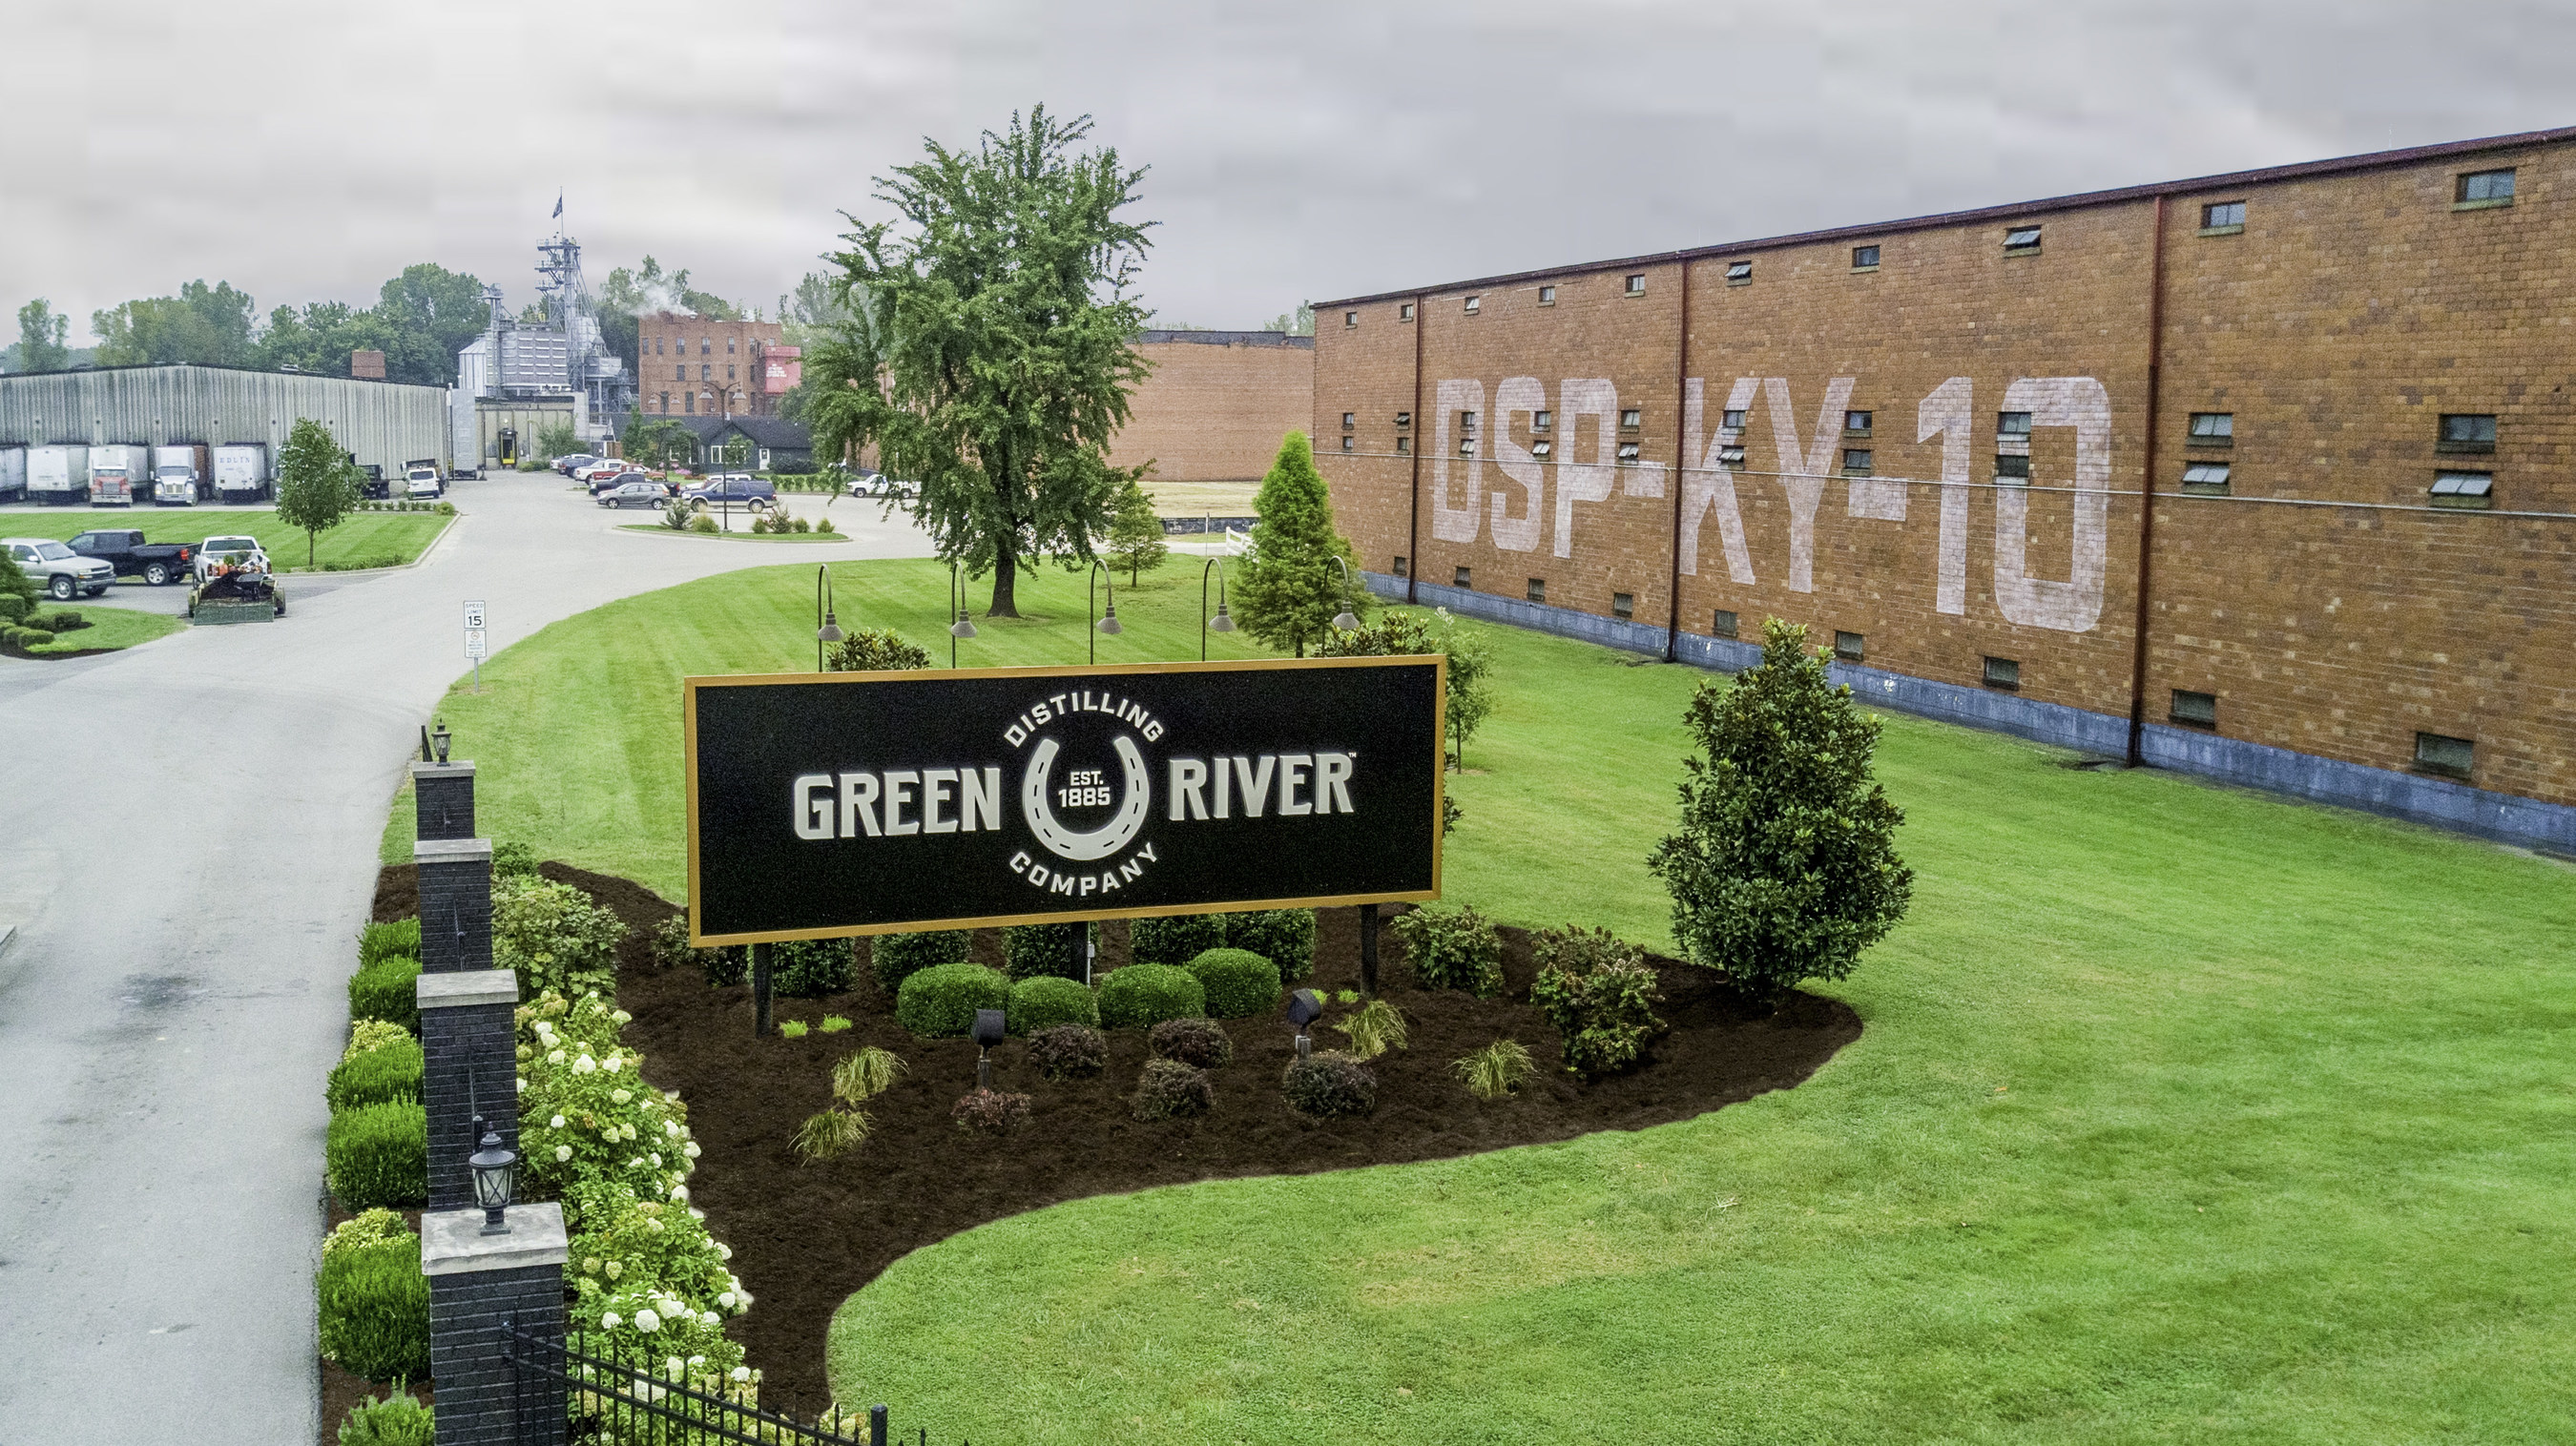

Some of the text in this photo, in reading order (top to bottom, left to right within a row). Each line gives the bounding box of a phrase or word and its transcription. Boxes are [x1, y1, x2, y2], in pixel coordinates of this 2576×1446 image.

[1431, 376, 2112, 633] DSP-KY-10
[467, 615, 483, 627] 15
[1004, 691, 1164, 748] DISTILLING
[794, 767, 1001, 840] GREEN
[1057, 786, 1111, 808] 1885
[1070, 770, 1105, 787] EST.
[1008, 841, 1158, 897] COMPANY
